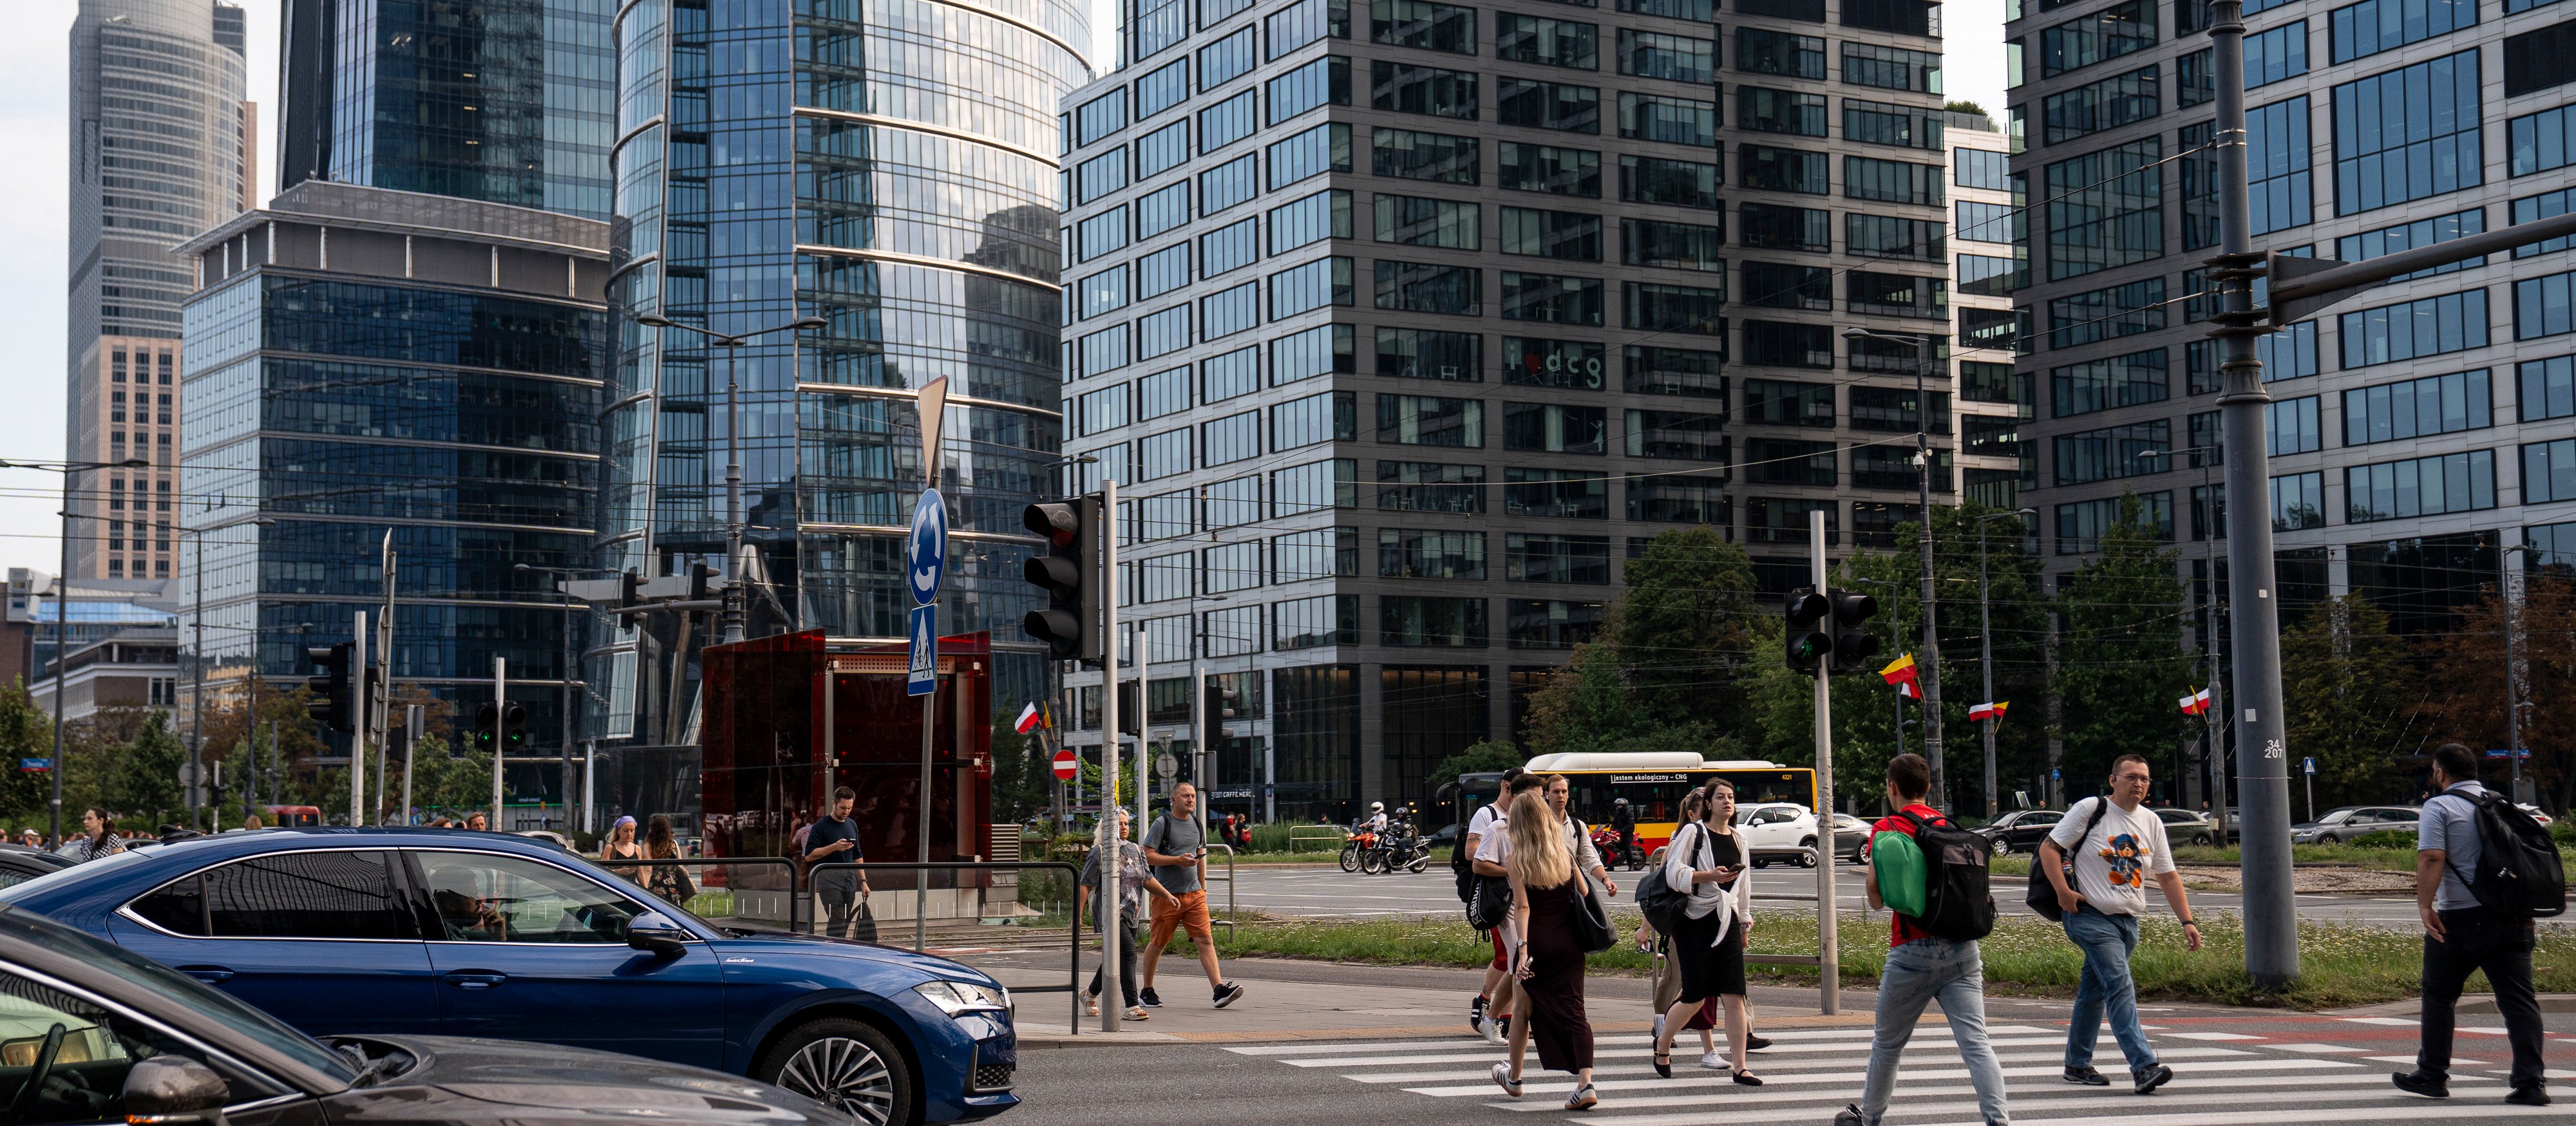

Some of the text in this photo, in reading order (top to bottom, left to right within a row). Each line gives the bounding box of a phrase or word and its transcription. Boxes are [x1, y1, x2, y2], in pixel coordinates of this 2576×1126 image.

[1546, 348, 1602, 389] dcg
[2267, 738, 2280, 749] 34
[2264, 748, 2283, 758] 207
